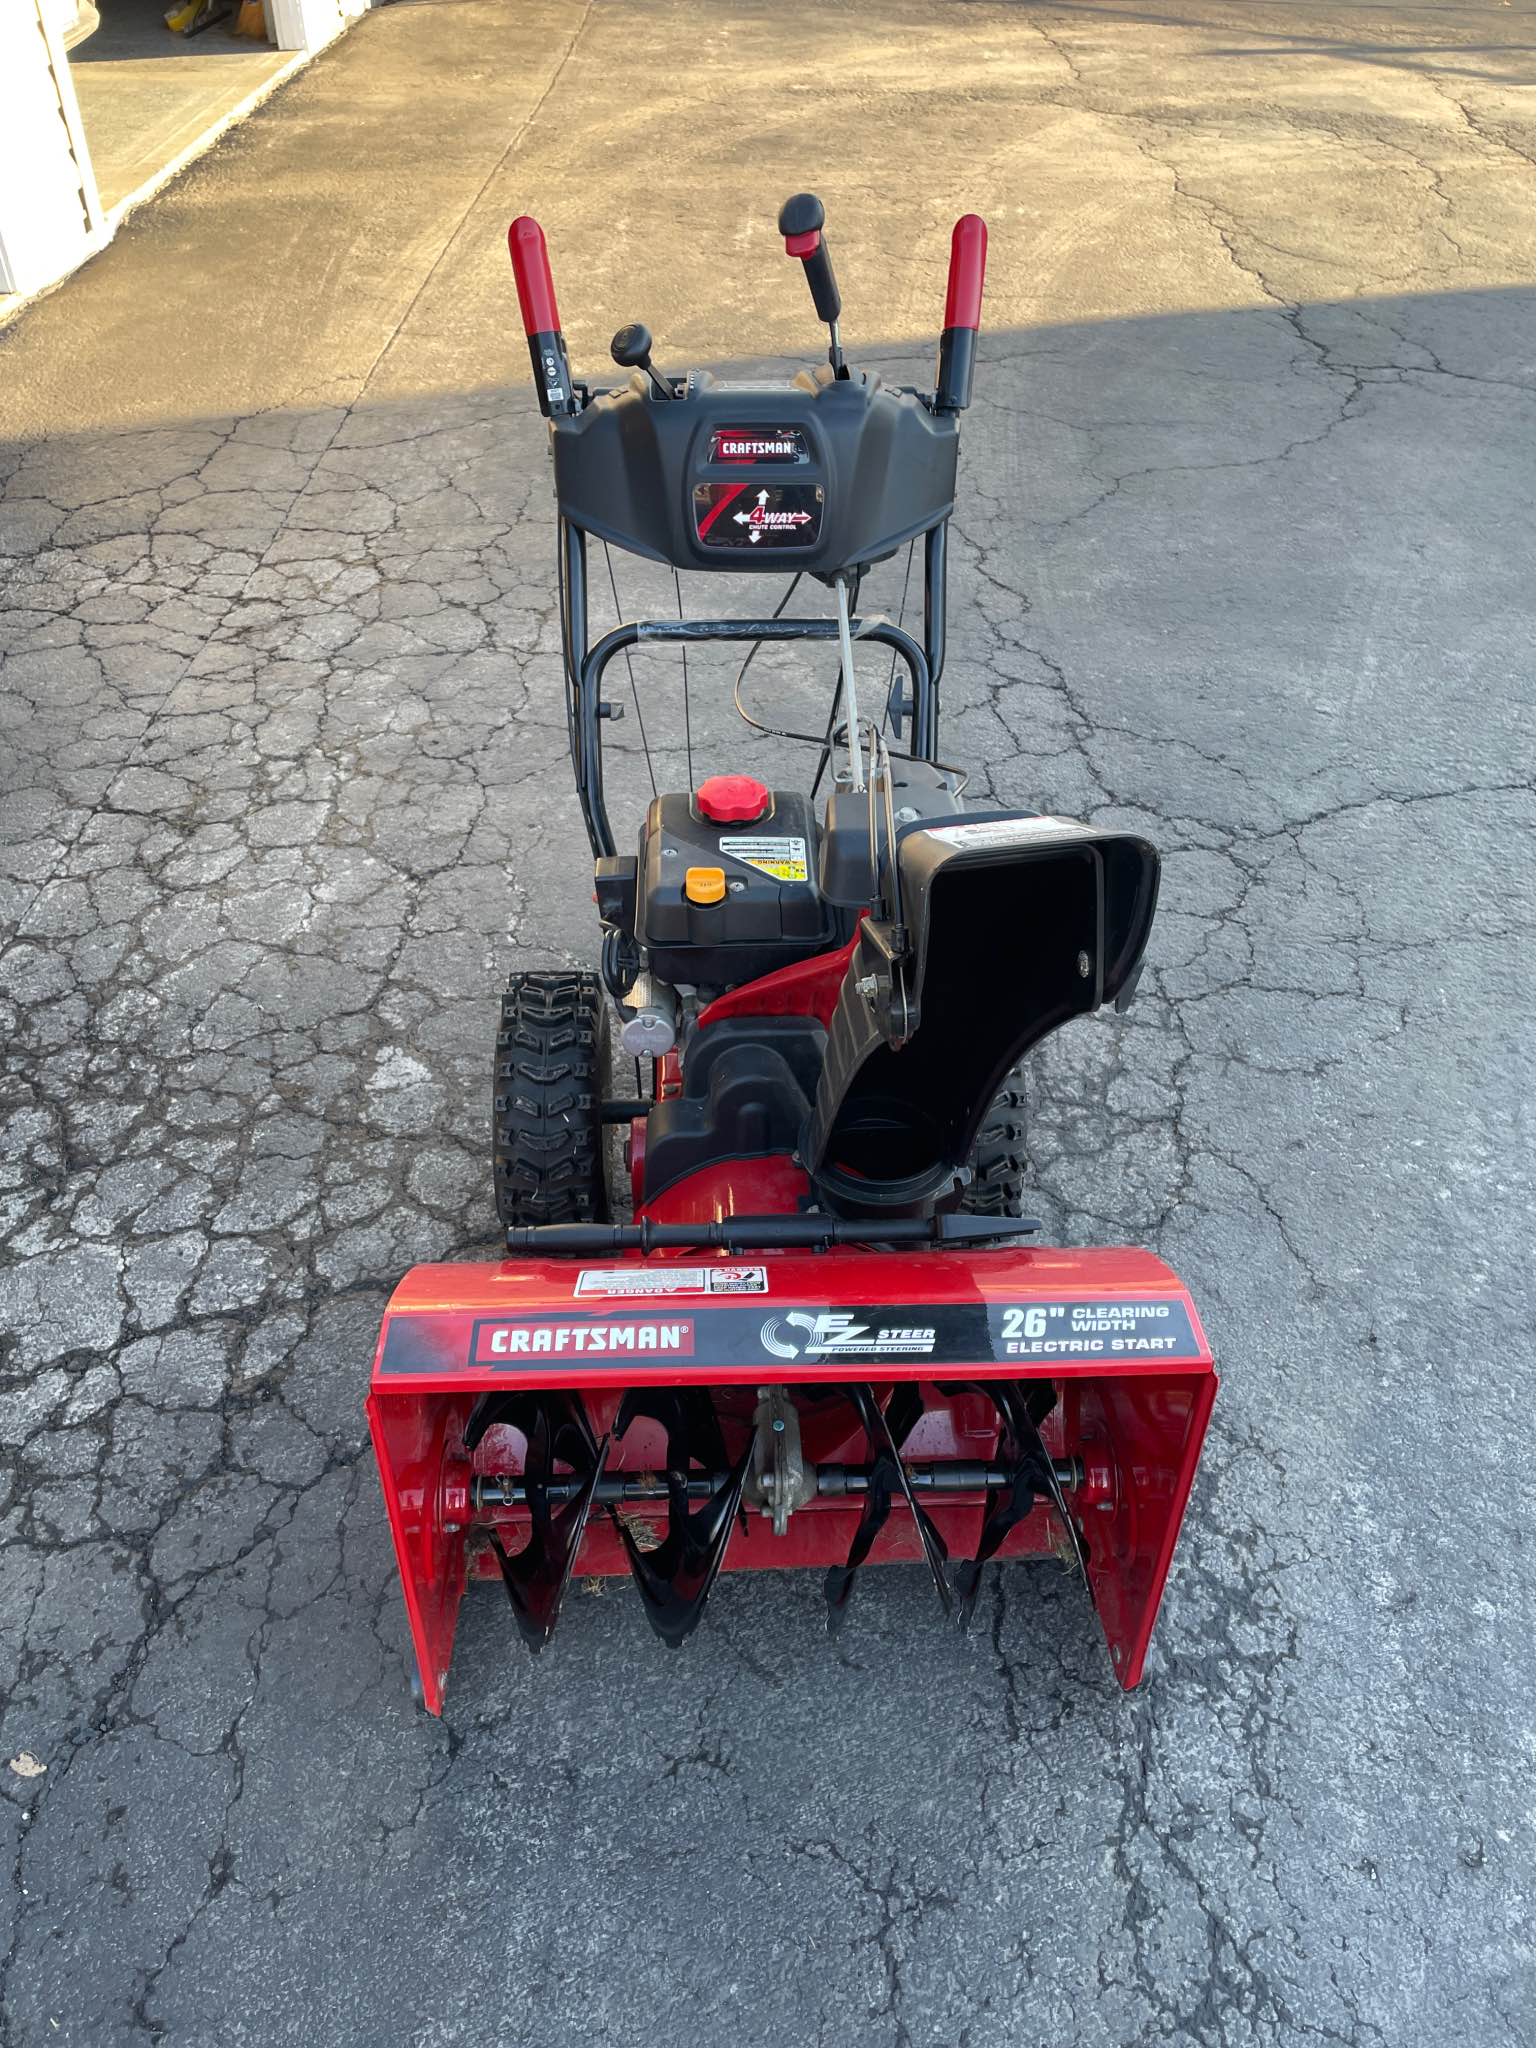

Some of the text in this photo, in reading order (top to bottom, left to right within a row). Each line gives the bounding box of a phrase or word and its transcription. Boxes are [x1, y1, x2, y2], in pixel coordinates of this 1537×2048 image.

[722, 442, 791, 454] CRAFTSMAN
[1072, 1306, 1169, 1319] CLEARING
[1071, 1319, 1136, 1332] WIDTH
[877, 1329, 936, 1339] STEER
[1006, 1337, 1177, 1354] ELECTRIC START
